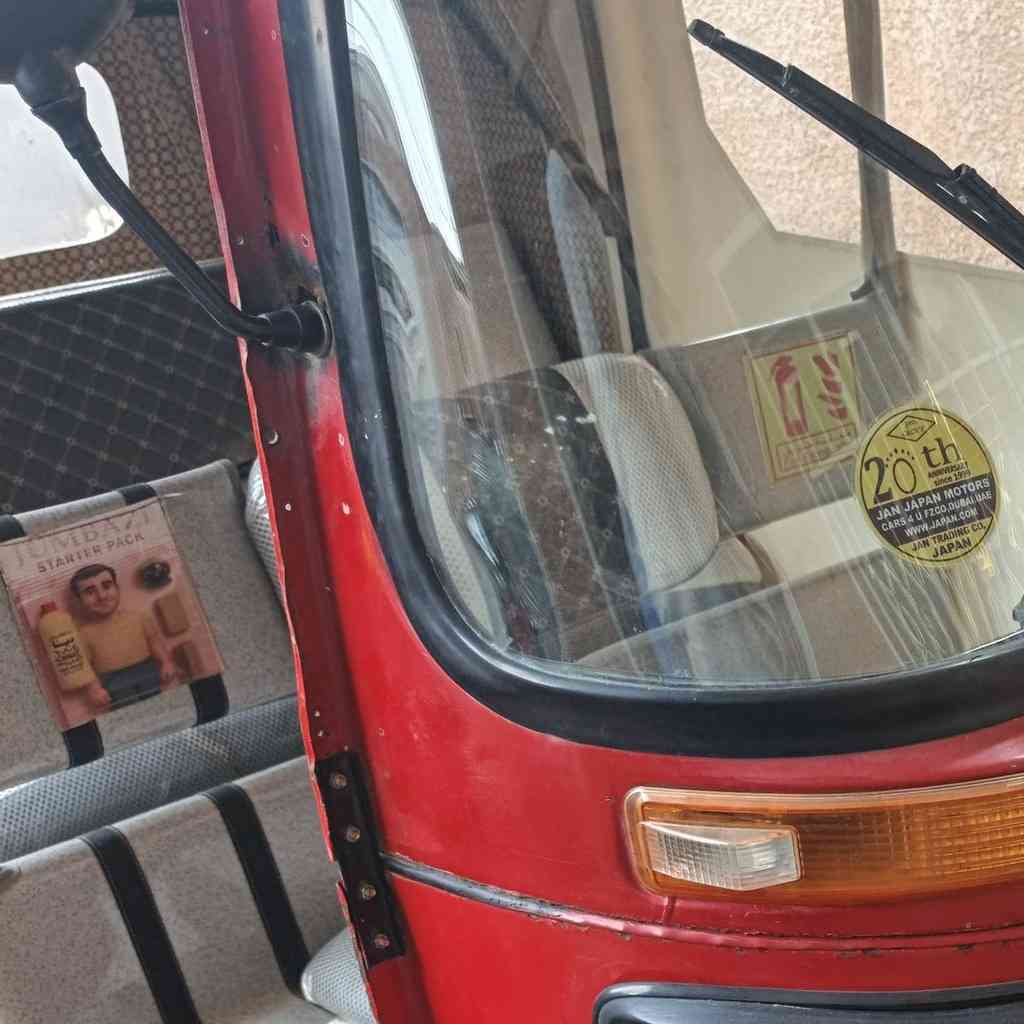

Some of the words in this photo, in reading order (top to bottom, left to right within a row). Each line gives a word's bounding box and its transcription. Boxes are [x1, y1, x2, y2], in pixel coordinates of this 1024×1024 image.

[876, 504, 900, 521] JAN
[904, 491, 942, 512] JAPAN
[944, 478, 990, 500] MOTORS
[881, 516, 907, 532] CARS
[908, 513, 915, 525] 4
[905, 507, 978, 537] WWW.JAPAN.COM
[37, 545, 101, 573] STARTER
[106, 533, 145, 554] PACK
[911, 538, 930, 552] JAN
[932, 527, 971, 547] TRADING
[932, 537, 972, 559] JAPAN
